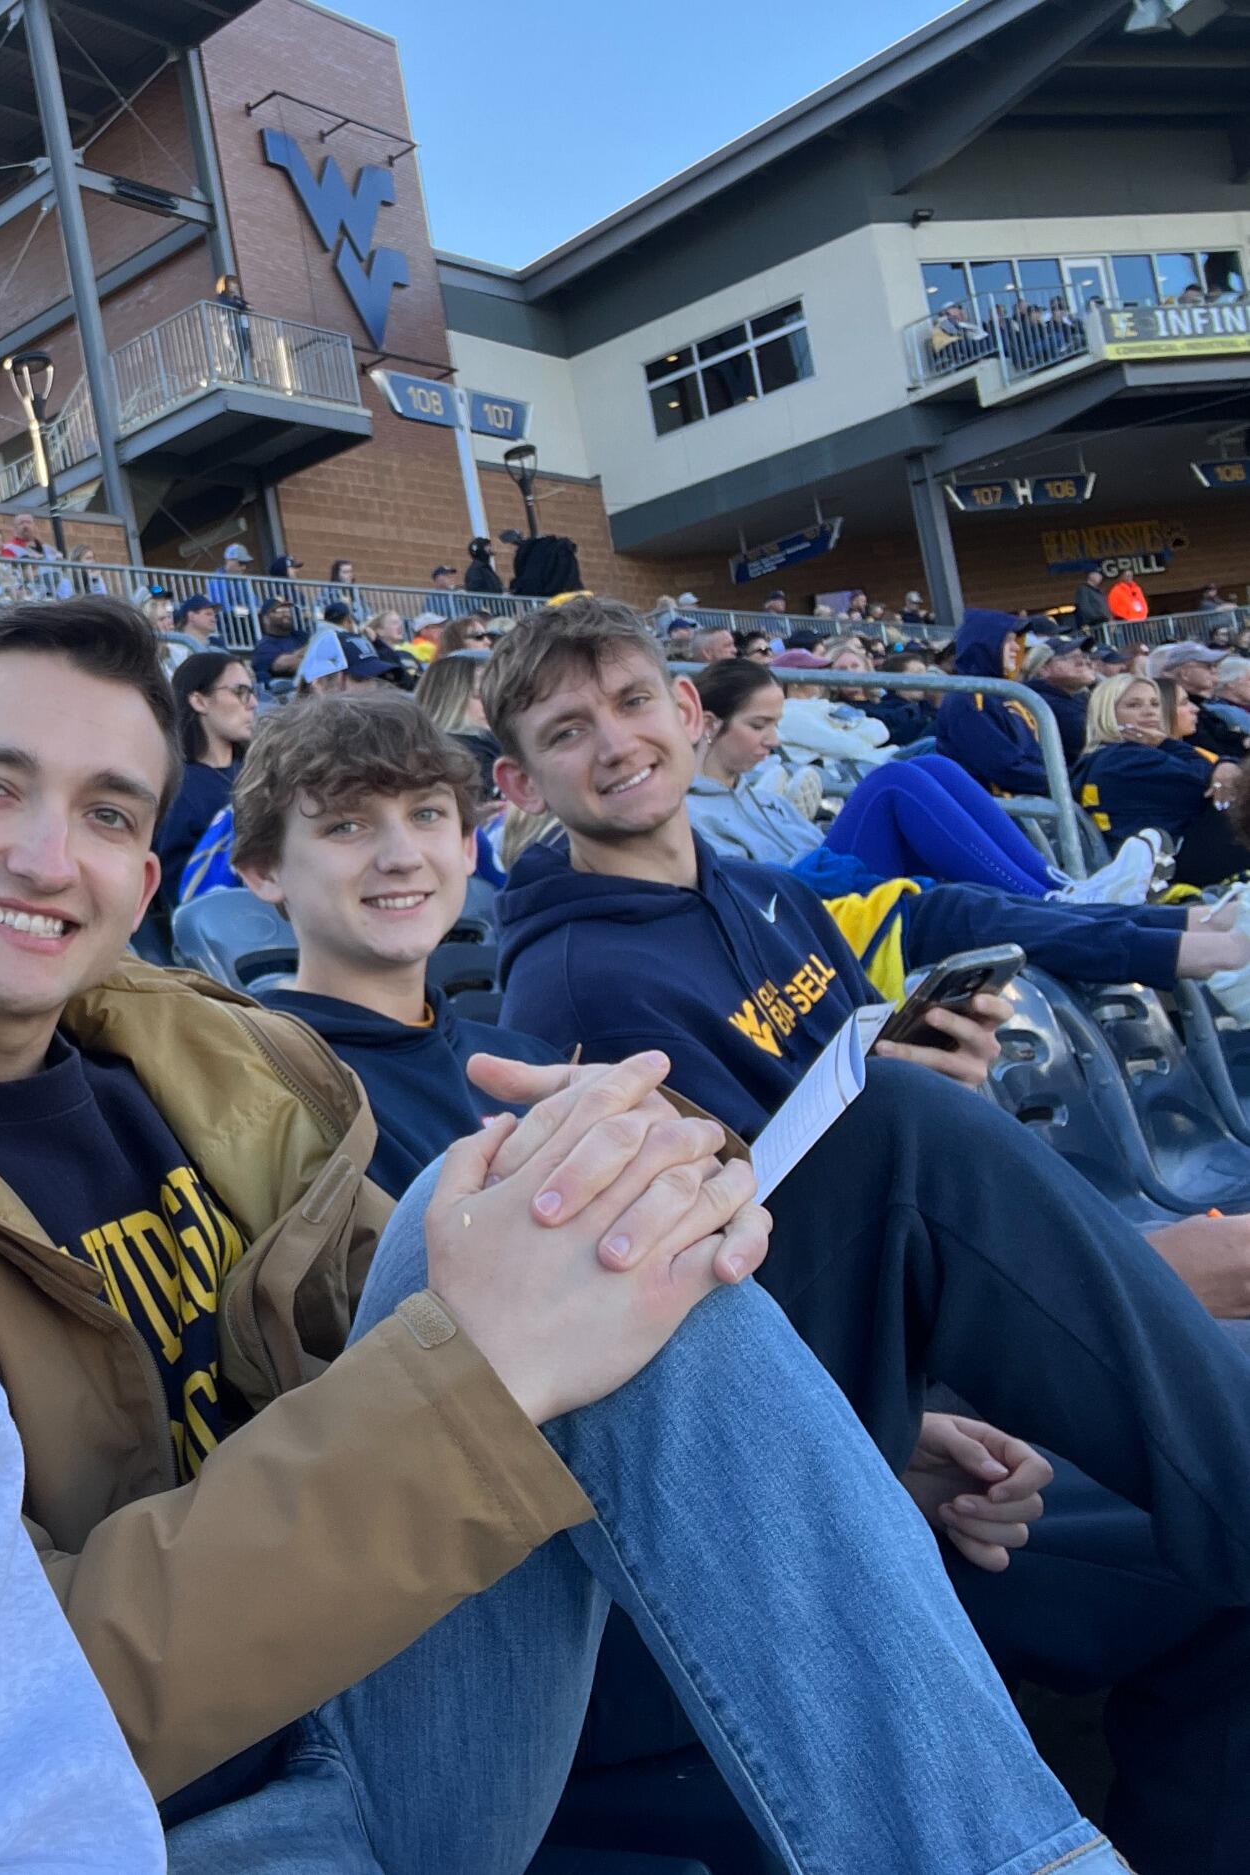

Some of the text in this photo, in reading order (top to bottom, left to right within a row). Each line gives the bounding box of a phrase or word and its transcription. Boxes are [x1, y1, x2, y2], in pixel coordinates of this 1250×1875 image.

[407, 385, 445, 417] 108
[483, 403, 514, 430] 107
[972, 485, 1002, 506] 107
